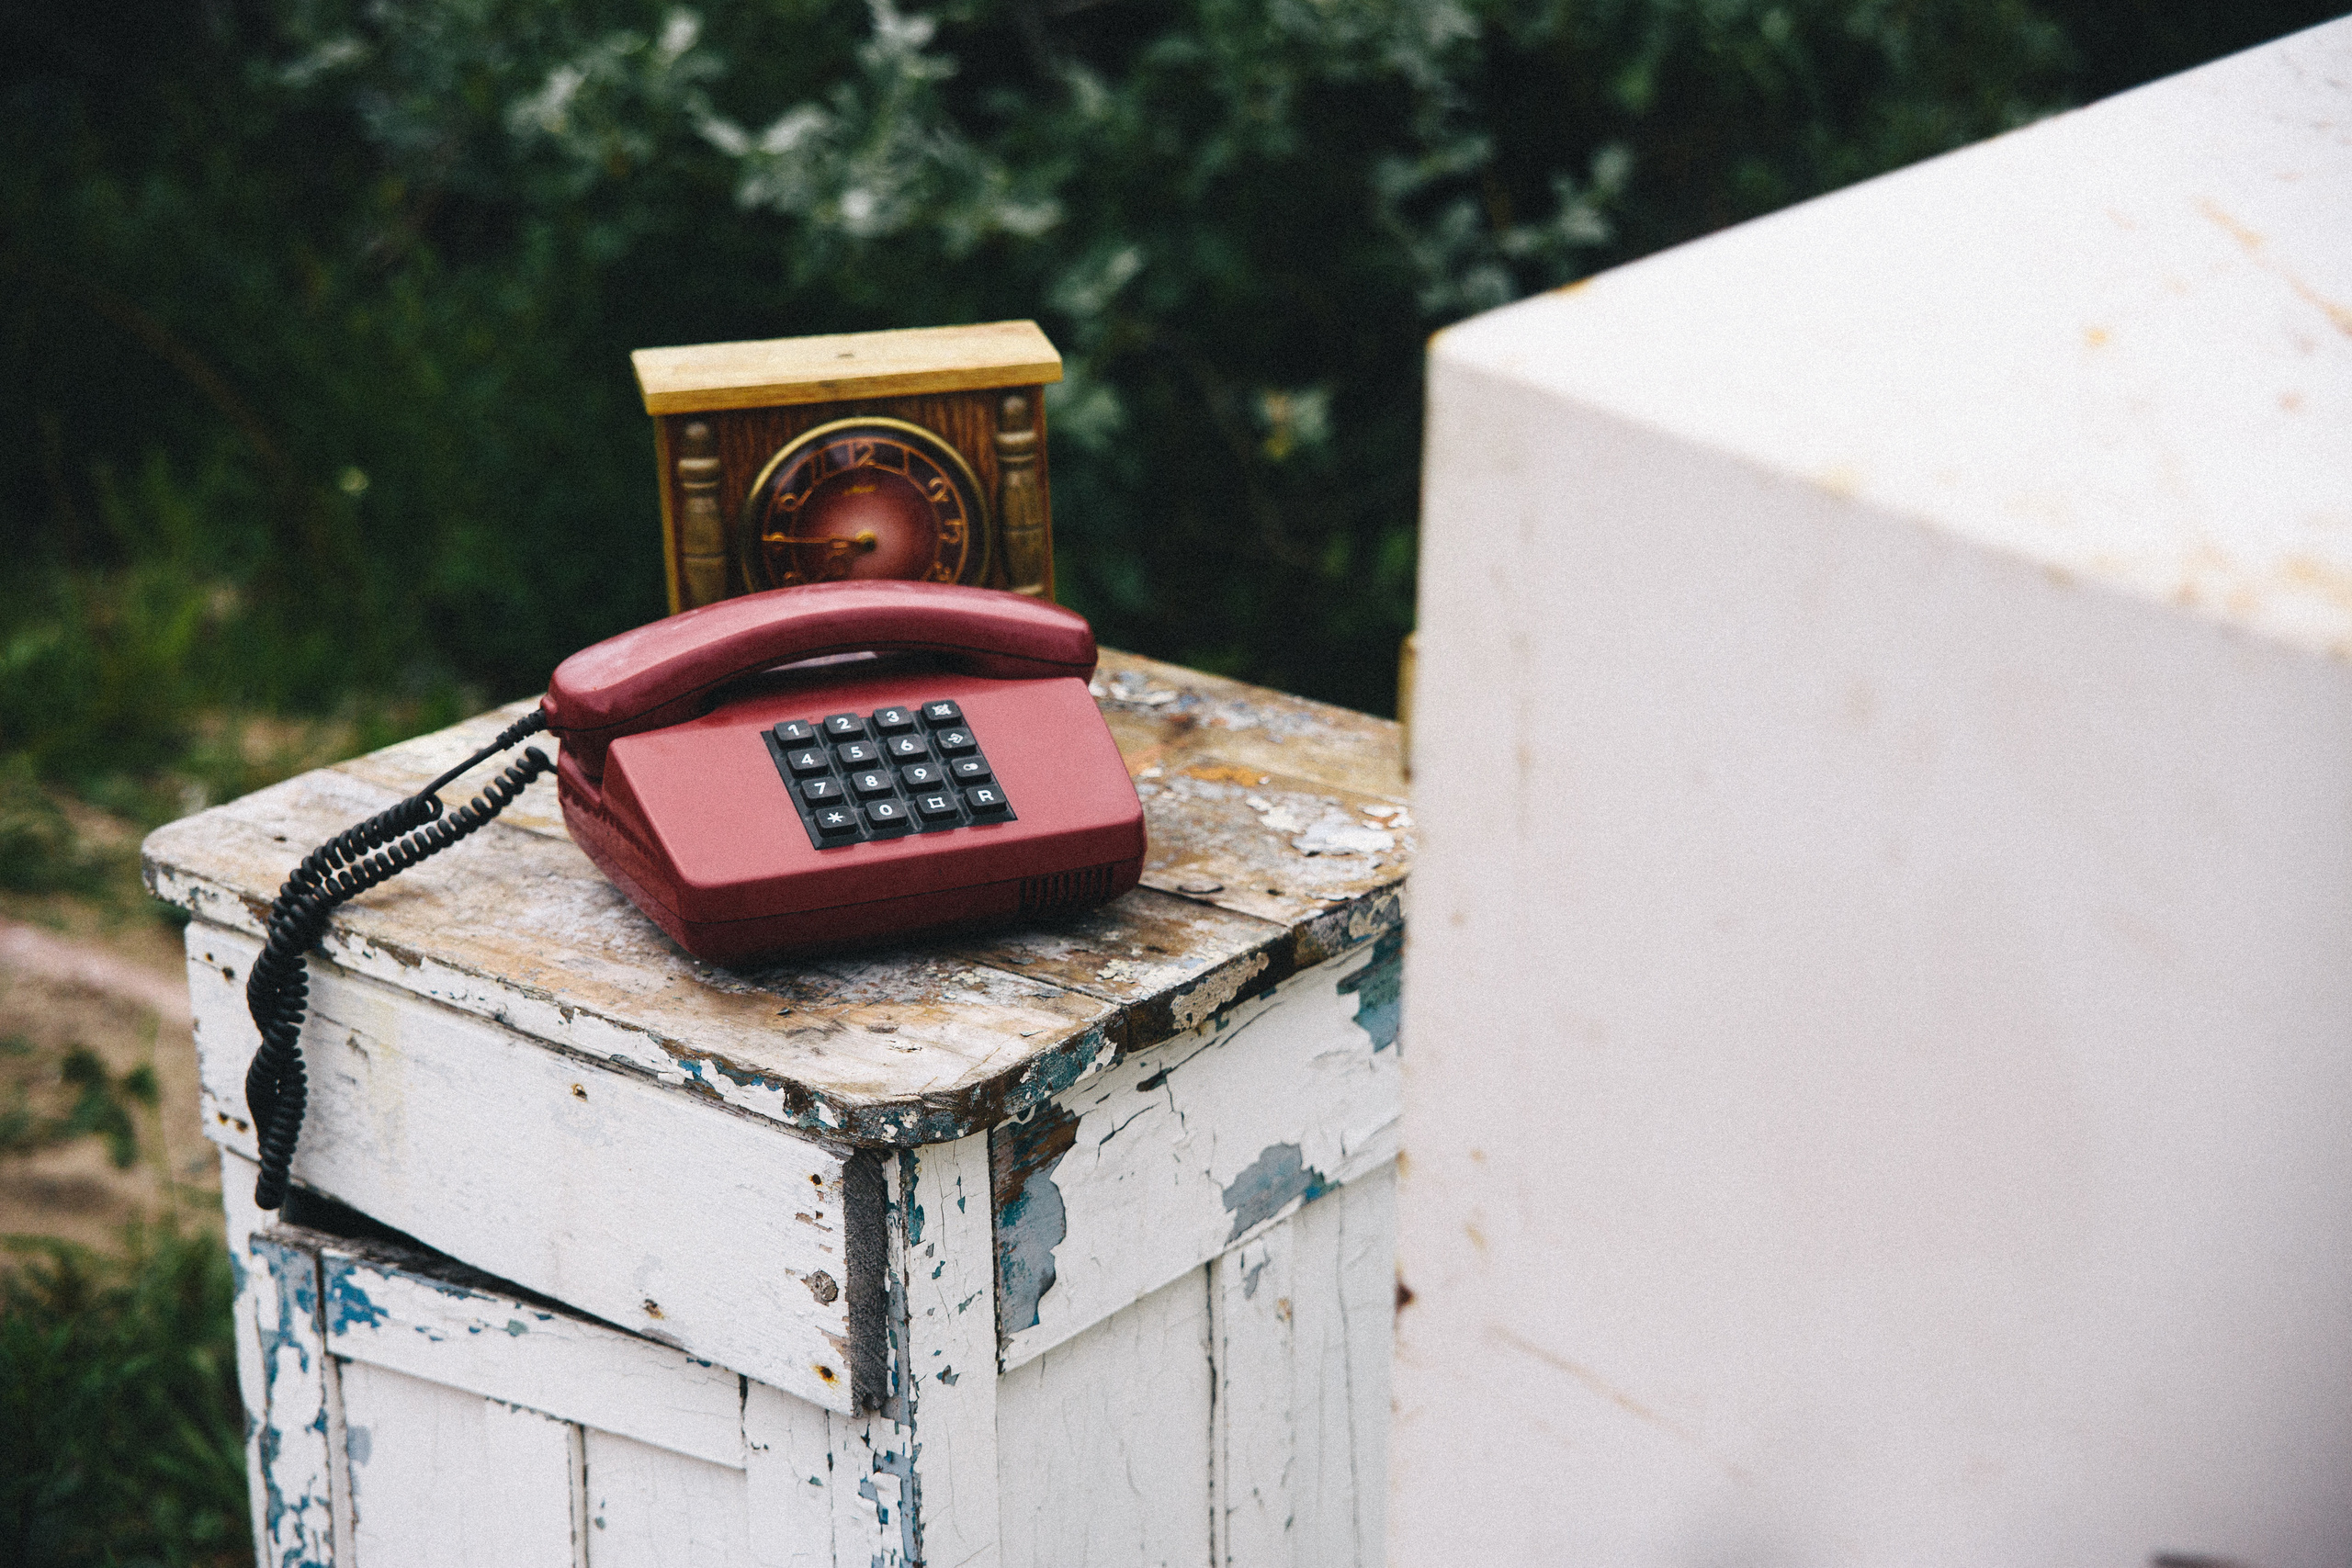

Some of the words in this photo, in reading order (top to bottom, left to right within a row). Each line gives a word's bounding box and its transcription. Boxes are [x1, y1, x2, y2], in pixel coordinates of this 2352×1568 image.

[848, 439, 876, 467] 12
[928, 476, 950, 502] 2
[939, 519, 961, 544] 3
[787, 724, 800, 737] 1
[837, 717, 852, 731] 2
[886, 710, 899, 723] 3
[801, 753, 814, 765] 4
[851, 746, 864, 759] 5
[900, 739, 914, 751] 6
[814, 782, 827, 795] 7
[865, 775, 878, 788] 8
[914, 767, 927, 780] 9
[879, 804, 893, 818] 0
[978, 790, 993, 803] R
